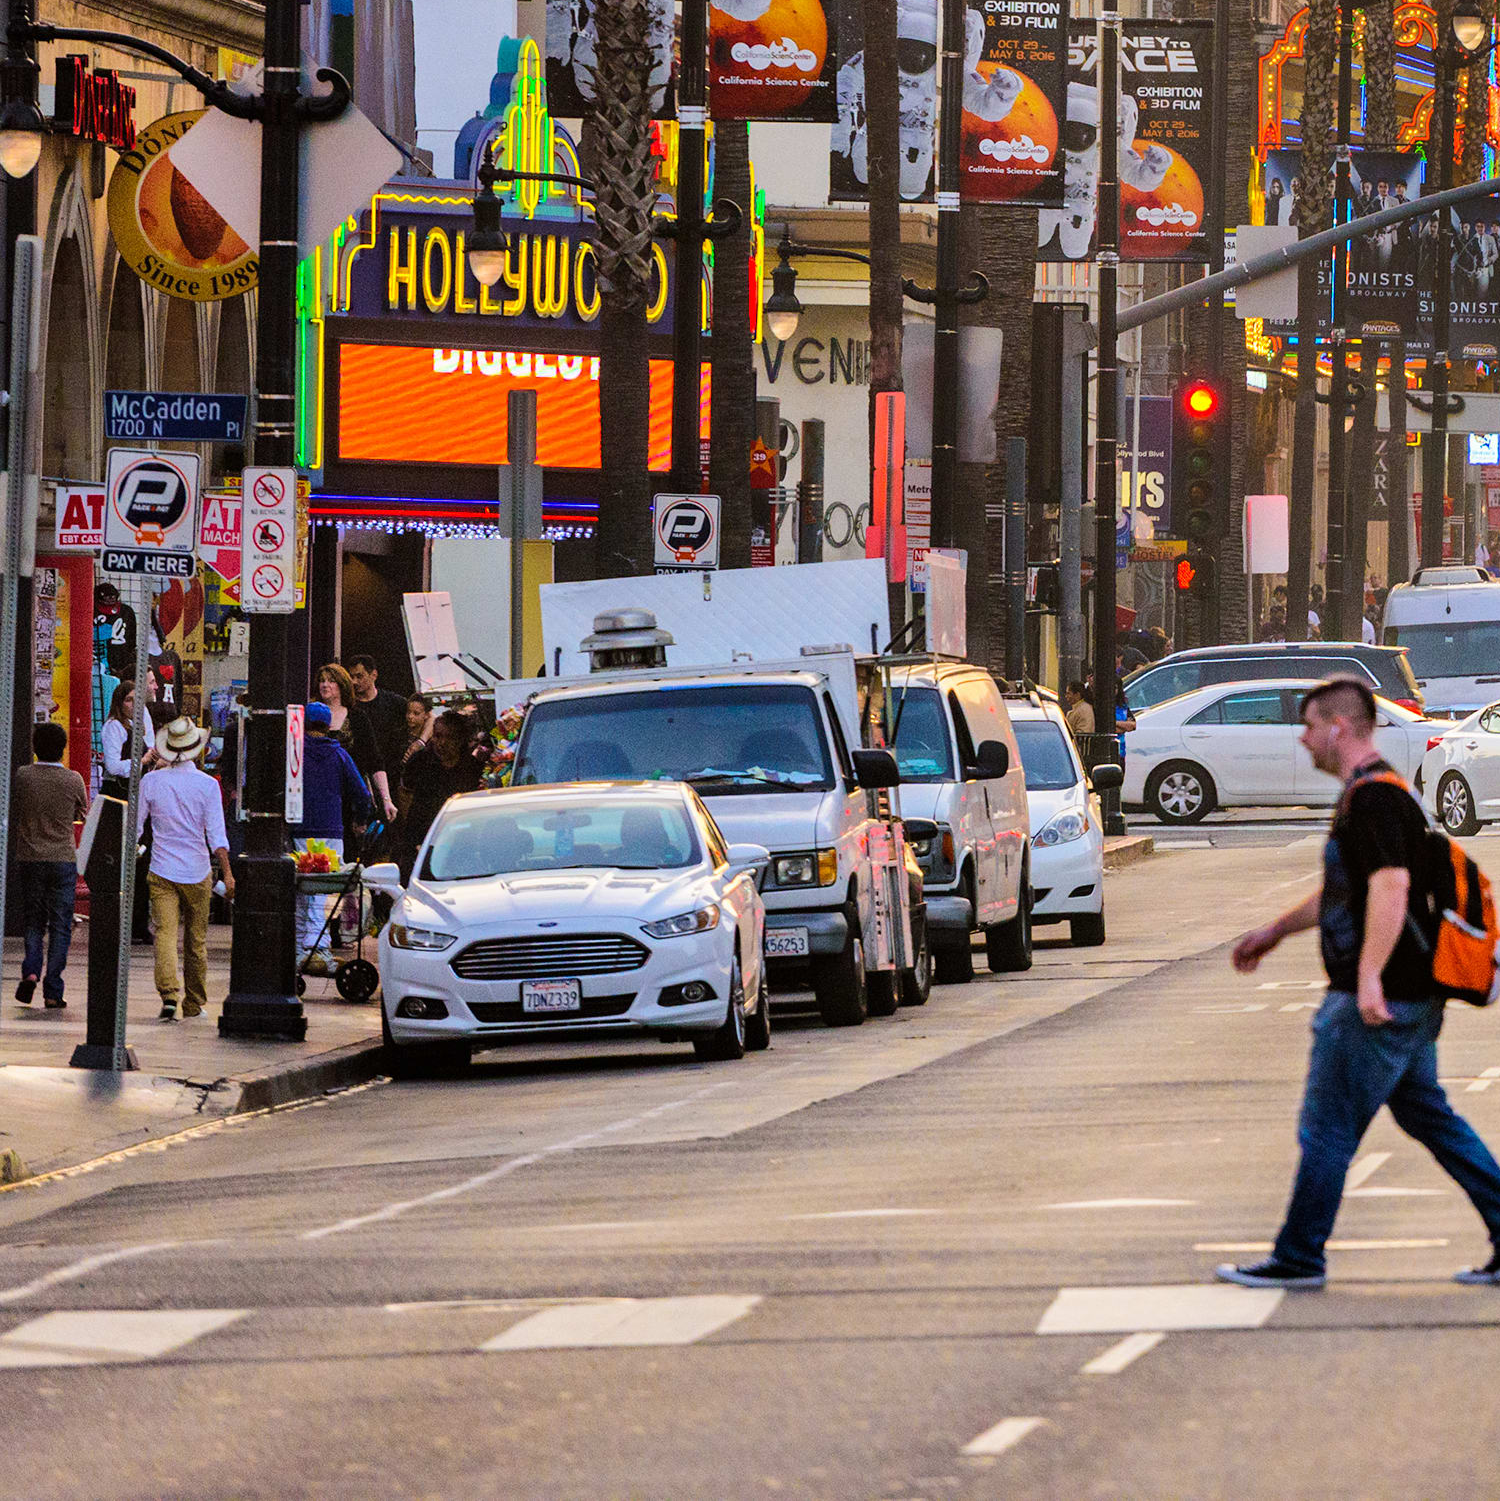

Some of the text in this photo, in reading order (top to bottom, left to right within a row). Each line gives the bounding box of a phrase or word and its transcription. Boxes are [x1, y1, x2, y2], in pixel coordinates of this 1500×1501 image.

[984, 0, 1060, 15] EXHIBITION
[719, 75, 829, 87] California Science Center
[968, 165, 1059, 177] California Science Center
[135, 253, 259, 296] Since 1989
[111, 394, 221, 421] McCadden
[111, 419, 163, 436] 1700 N
[753, 453, 767, 462] 39
[1373, 438, 1389, 507] ZARA
[60, 494, 106, 530] AT
[203, 499, 241, 530] AT
[108, 555, 188, 573] PAY HERE
